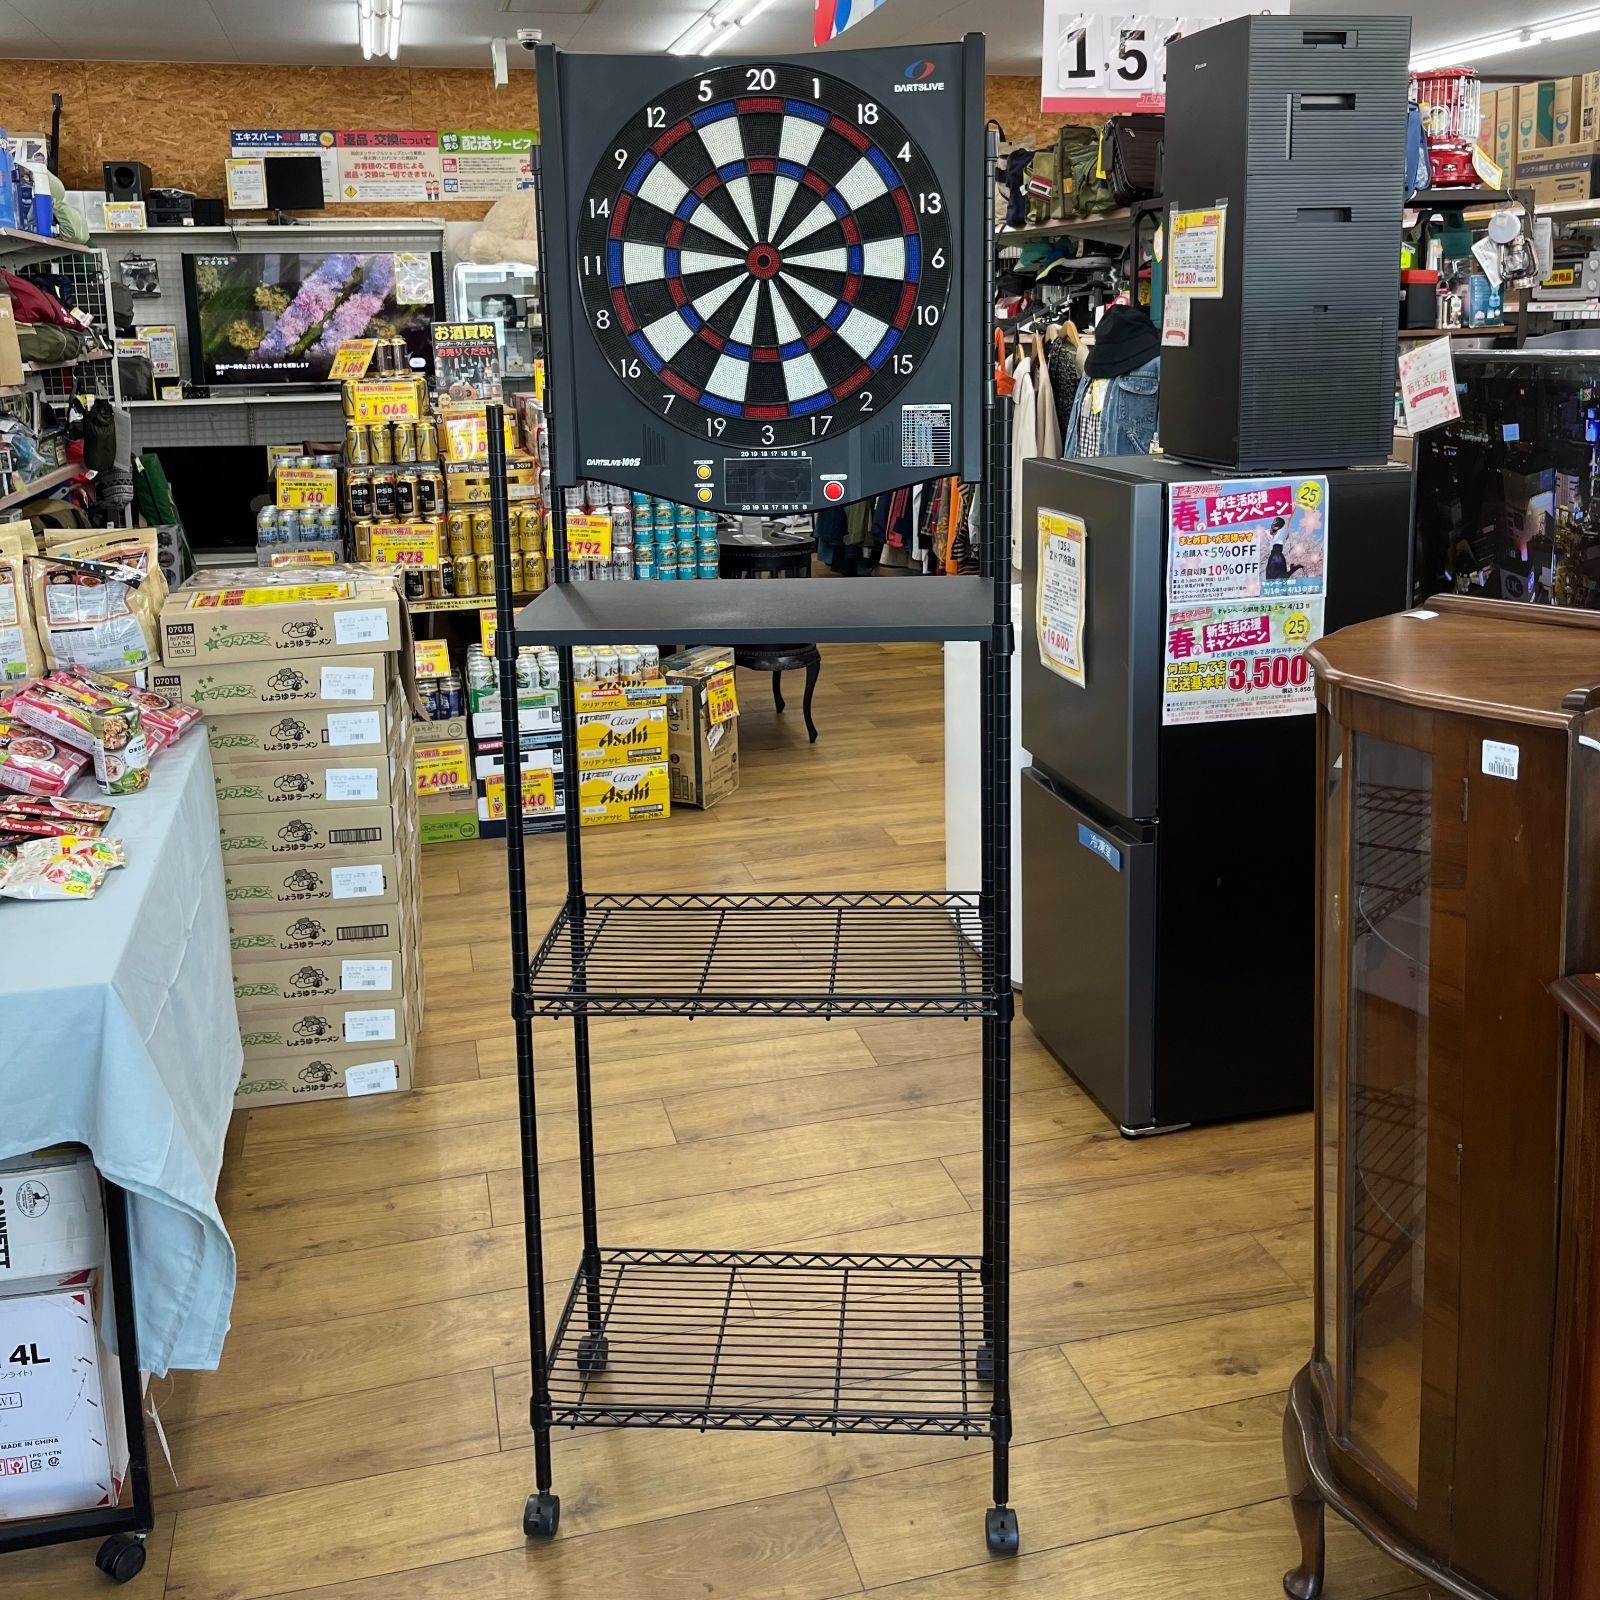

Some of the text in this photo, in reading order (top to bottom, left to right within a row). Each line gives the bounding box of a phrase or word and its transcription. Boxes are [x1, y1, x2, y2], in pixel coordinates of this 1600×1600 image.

[746, 68, 776, 90] 20
[812, 78, 820, 99] 1
[894, 82, 944, 92] DARTSLIVE
[698, 80, 712, 102] 5
[646, 107, 666, 128] 12
[857, 103, 878, 124] 18
[344, 134, 432, 146] 返品・交換について
[462, 136, 532, 150] 配送サービス
[614, 149, 628, 170] 9
[897, 141, 912, 162] 4
[590, 198, 610, 218] 14
[919, 192, 942, 214] 13
[583, 256, 601, 276] 11
[932, 248, 945, 268] 6
[596, 310, 610, 330] 8
[916, 306, 938, 326] 10
[434, 324, 494, 340] お酒買取
[437, 348, 496, 356] お売りください
[620, 358, 641, 378] 16
[892, 354, 913, 374] 15
[1407, 370, 1448, 394] 新生活応援
[662, 394, 676, 414] 7
[859, 392, 872, 412] 2
[706, 418, 726, 438] 19
[762, 425, 774, 444] 3
[811, 416, 832, 436] 17
[300, 492, 322, 502] 140
[1216, 490, 1268, 510] 新生活応援
[1300, 486, 1318, 502] 25
[1172, 500, 1206, 532] 春の
[1210, 502, 1289, 526] キャンペーン
[1180, 533, 1254, 546] まとめ買いがお得です
[396, 552, 424, 563] 828
[1050, 550, 1076, 568] 2ドア冷蔵庫
[1176, 544, 1256, 558] 2点購入で 5%OFF
[1208, 562, 1258, 576] 10%OFF
[168, 626, 192, 634] 07018
[1206, 618, 1262, 638] 新生活応援
[1288, 620, 1305, 634] 25
[276, 638, 332, 648] しょうゆラーメン
[1168, 628, 1202, 660] 春の
[1206, 630, 1267, 650] キャンペーン
[1168, 660, 1226, 675] 何点買っても
[1228, 654, 1308, 694] 3,500
[155, 678, 180, 686] 07018
[1166, 672, 1226, 693] 配送基本料
[262, 692, 316, 702] しょうゆラーメン
[610, 716, 639, 726] Clear
[264, 742, 318, 750] しょうゆラーメン
[599, 725, 648, 748] Asahi
[418, 772, 458, 788] 2,400
[613, 773, 641, 783] Clear
[268, 793, 322, 802] しょうゆラーメン
[600, 781, 650, 804] Asahi
[272, 842, 326, 852] しょうゆラーメン
[1090, 833, 1112, 861] 冷凍室
[278, 892, 331, 902] しょうゆラーメン
[280, 940, 334, 950] しょうゆラーメン
[284, 988, 336, 998] しょうゆラーメン
[286, 1036, 339, 1046] しょうゆラーメン
[292, 1082, 344, 1093] しょうゆラーメン
[9, 1343, 50, 1366] 4L
